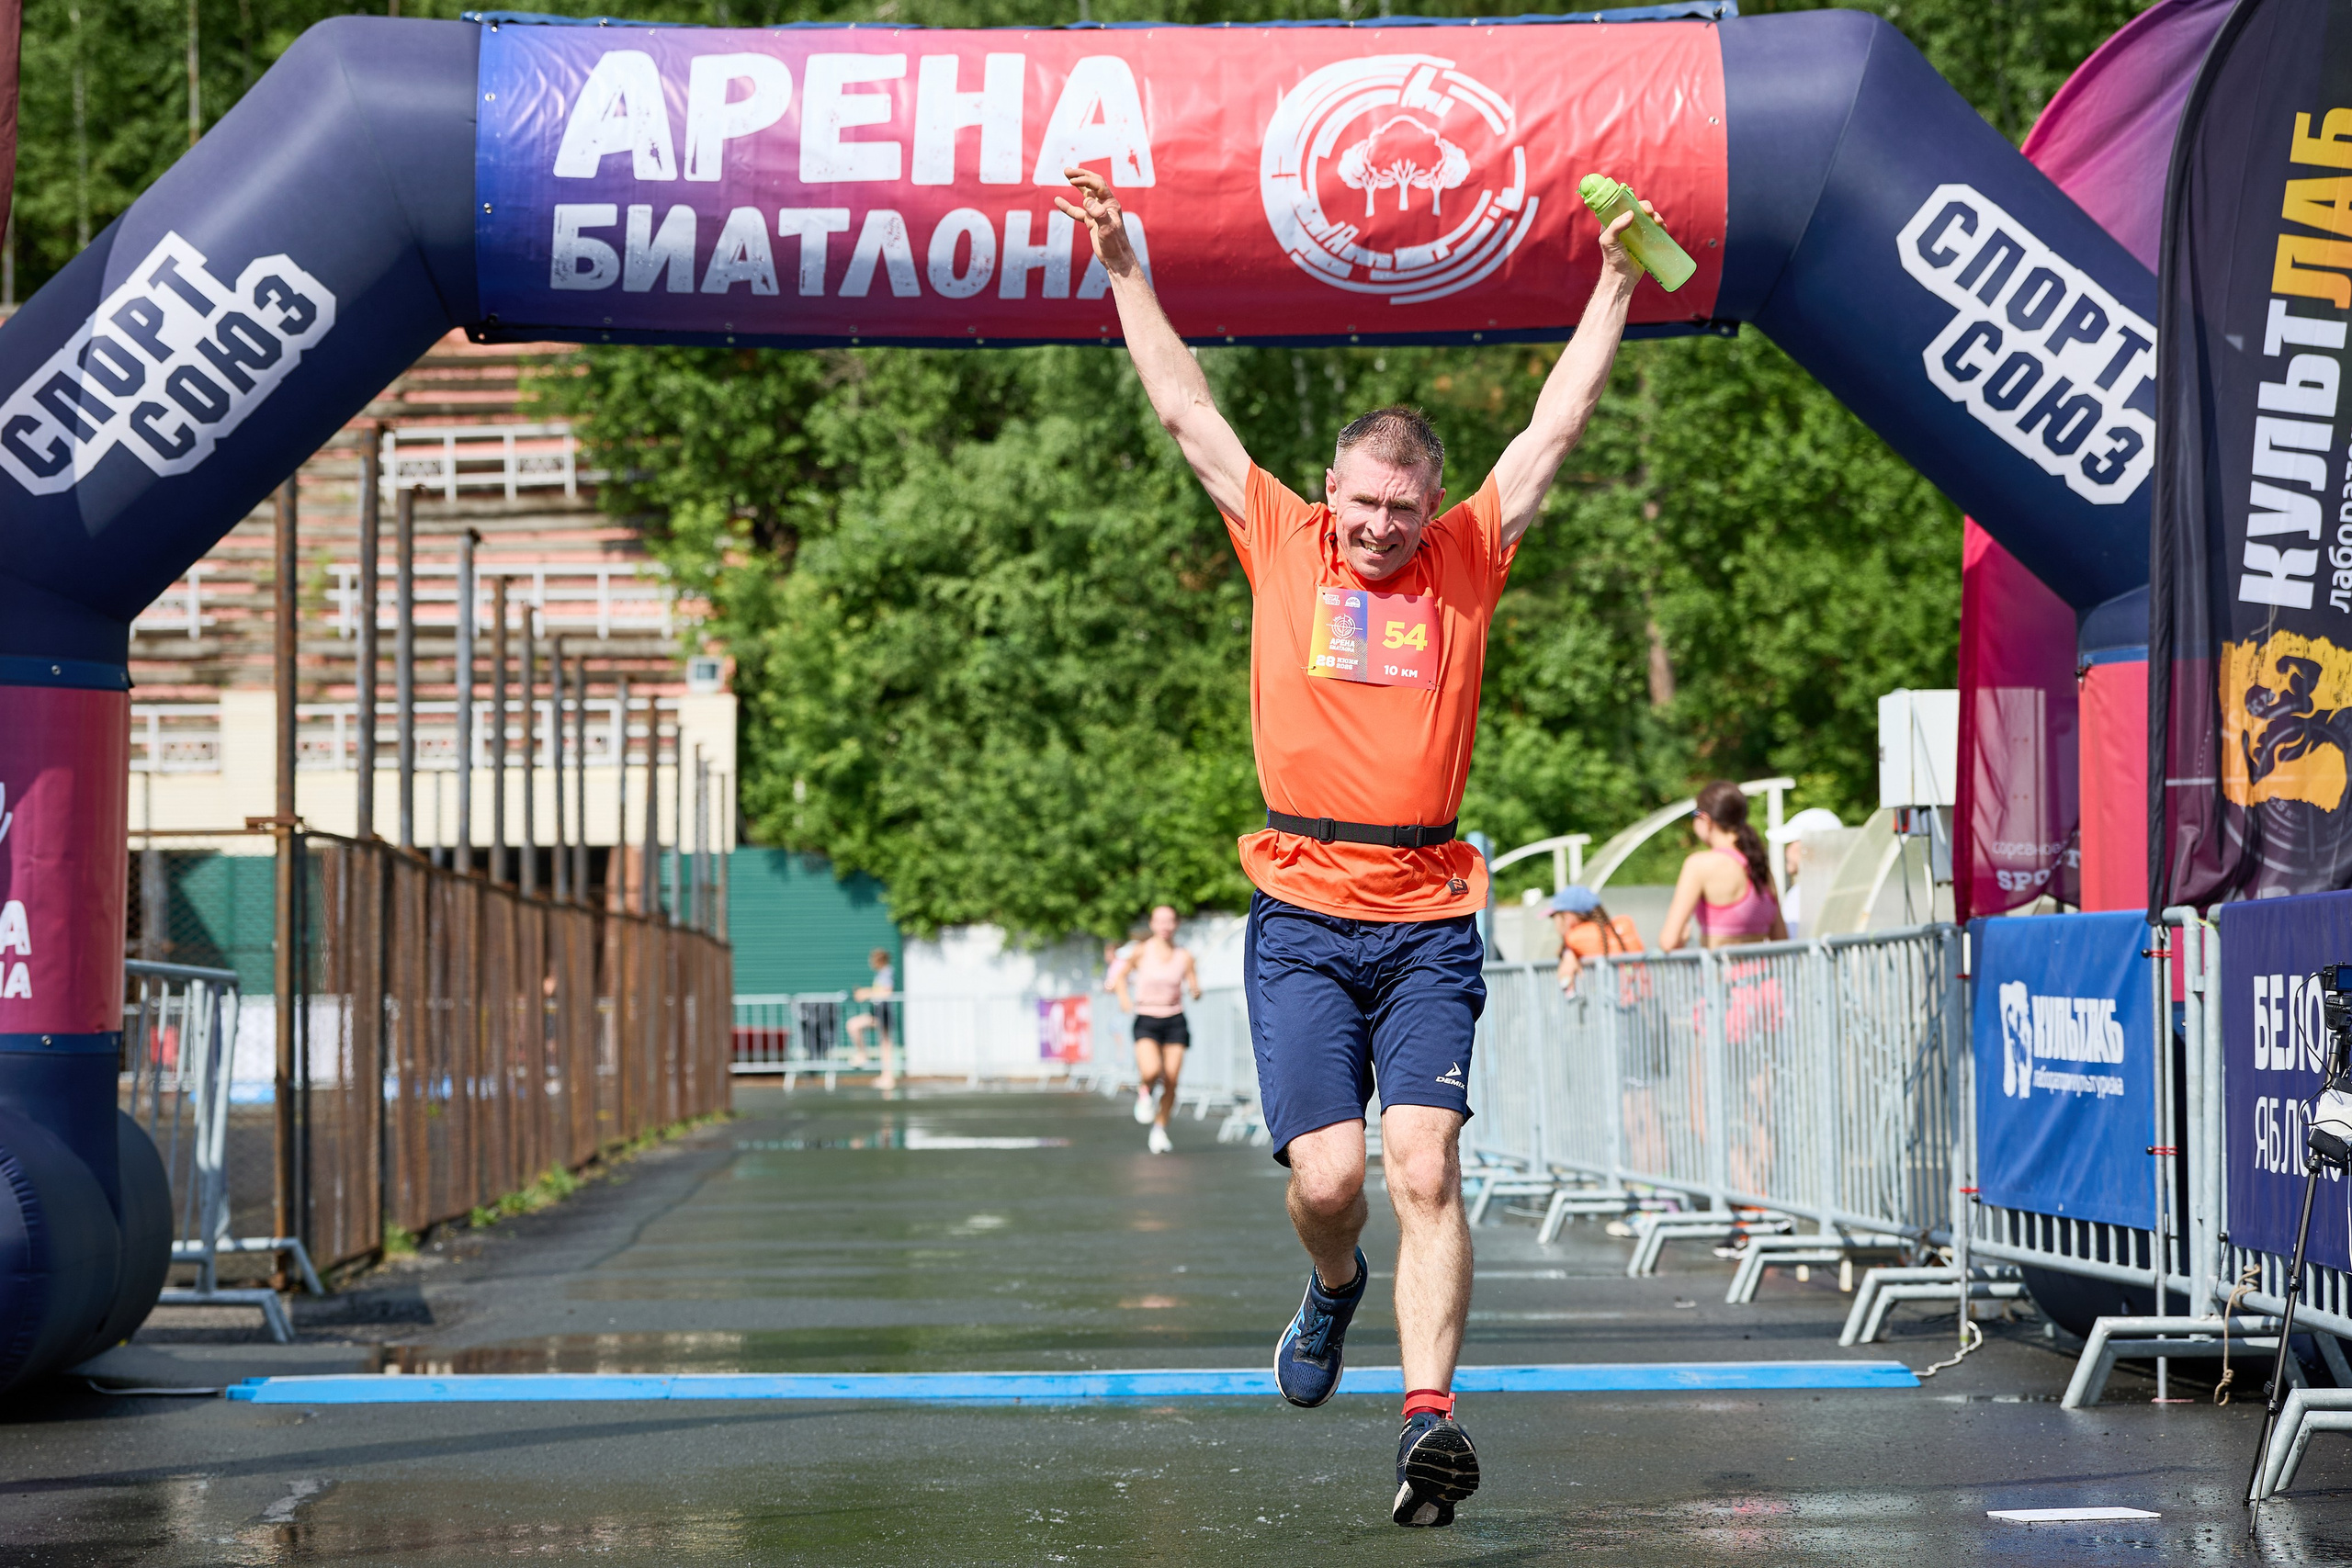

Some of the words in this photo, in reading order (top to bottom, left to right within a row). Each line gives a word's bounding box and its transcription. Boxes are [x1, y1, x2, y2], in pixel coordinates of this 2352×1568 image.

[553, 50, 1156, 187] АРЕНА
[1917, 201, 2153, 391] СПОРТ
[1, 254, 216, 478] СПОРТ
[130, 275, 317, 460] СОЮЗ
[1942, 321, 2144, 486] СОЮЗ
[2238, 107, 2352, 610] КУЛЬТЛАБ
[1316, 654, 1336, 668] 28
[1330, 637, 1355, 649] АРЕНА
[1382, 621, 1429, 651] 54
[1384, 664, 1398, 676] 10
[1435, 1076, 1465, 1089] DEMIX
[2254, 972, 2340, 1074] БЕЛО
